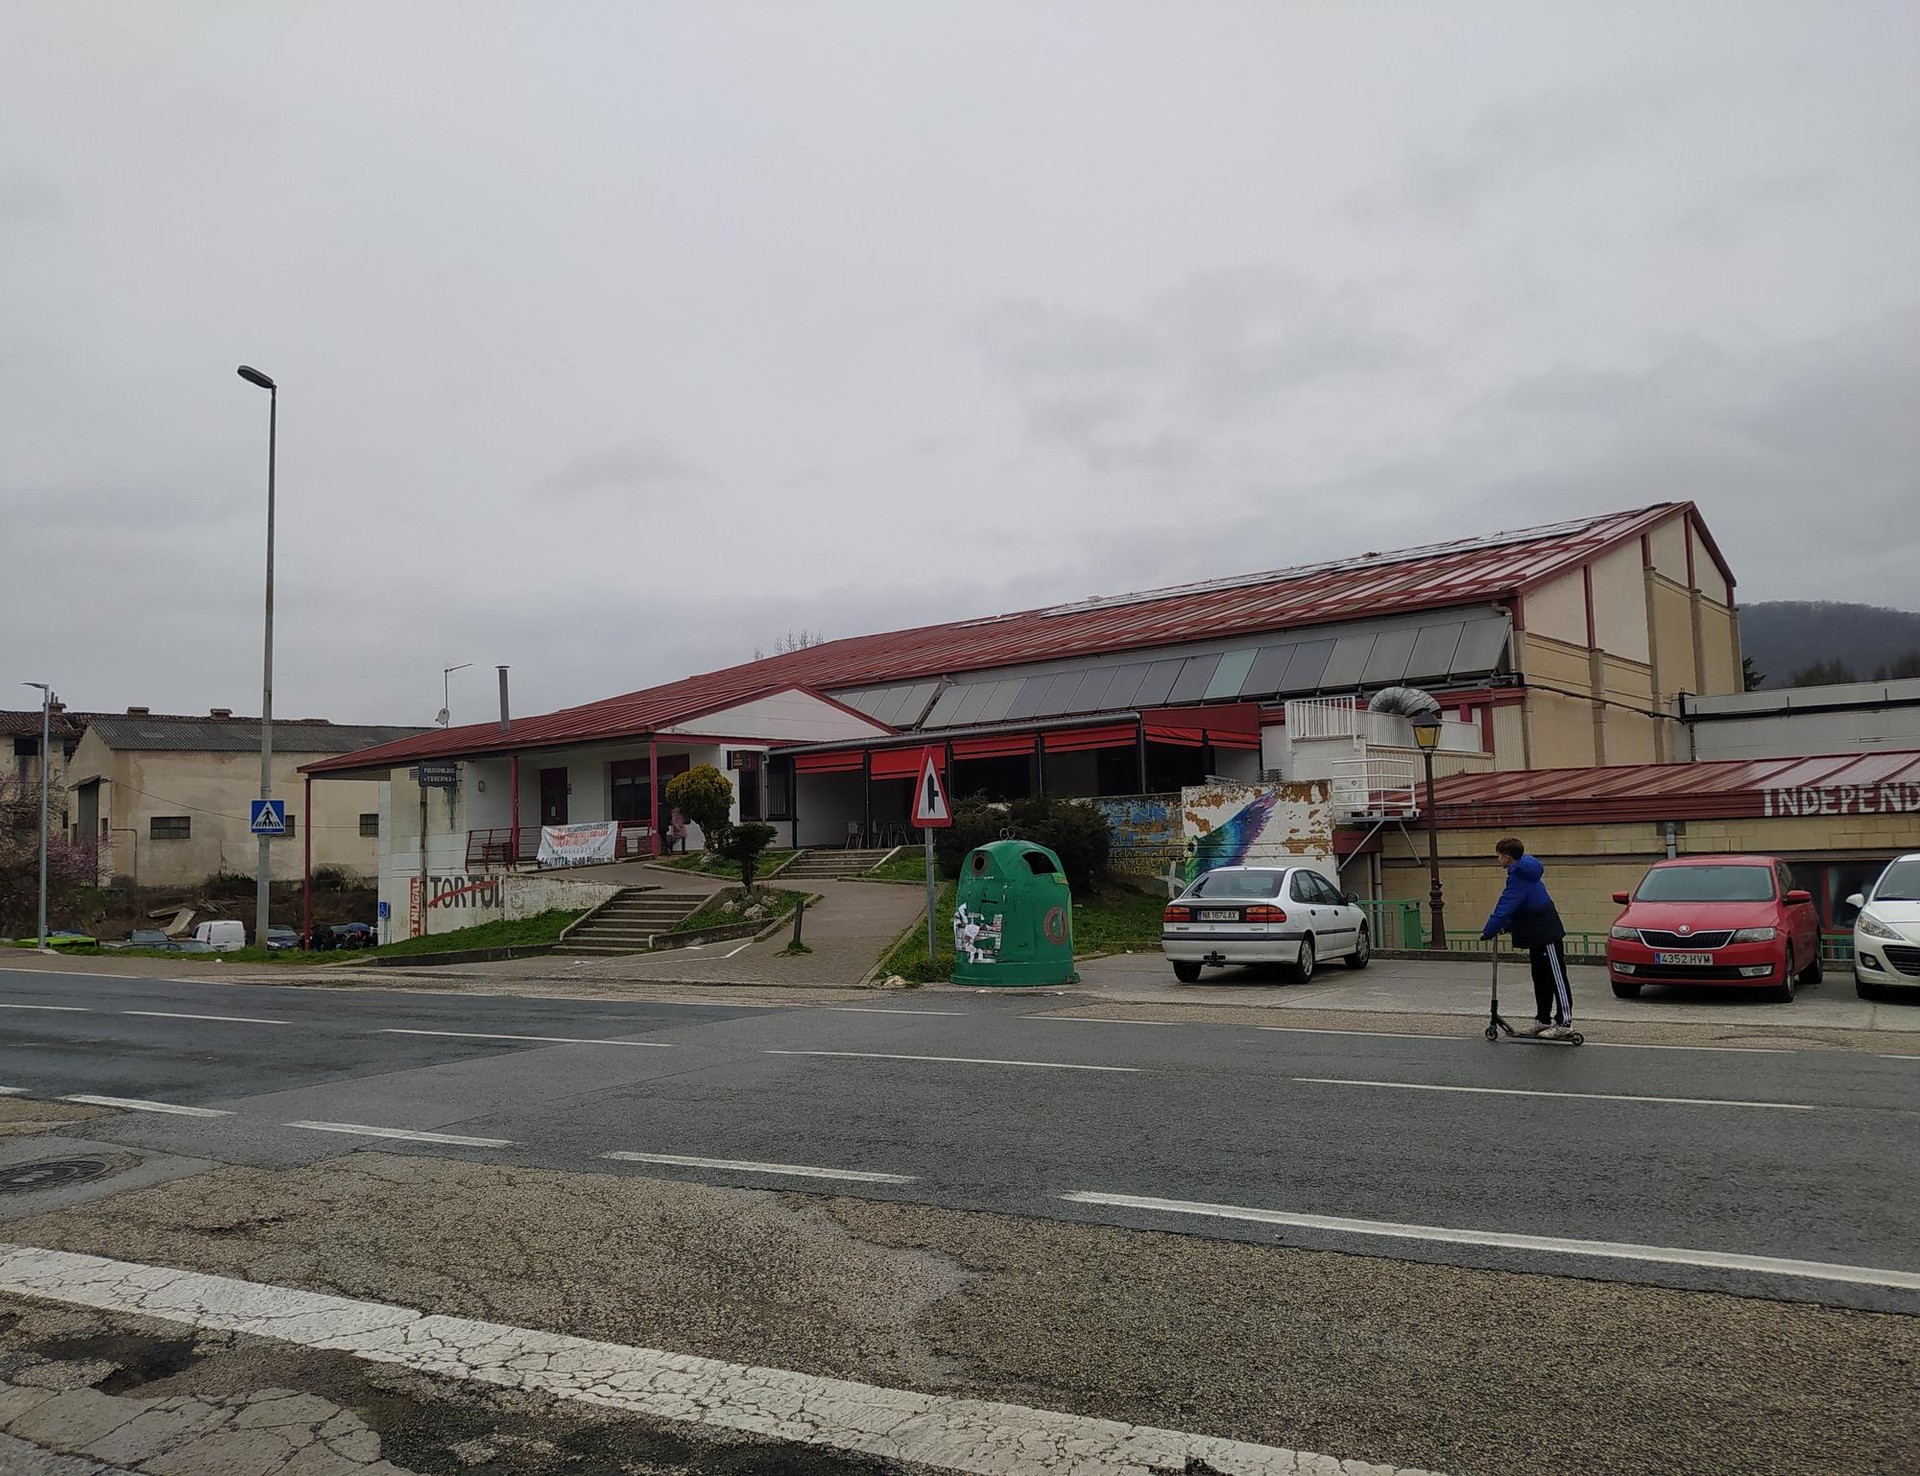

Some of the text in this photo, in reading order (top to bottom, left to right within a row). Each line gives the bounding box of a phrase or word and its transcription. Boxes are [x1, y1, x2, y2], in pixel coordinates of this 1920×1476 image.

[1763, 782, 1920, 817] INDEPEND
[1202, 911, 1210, 920] NA
[1661, 954, 1710, 964] 4352 HVM
